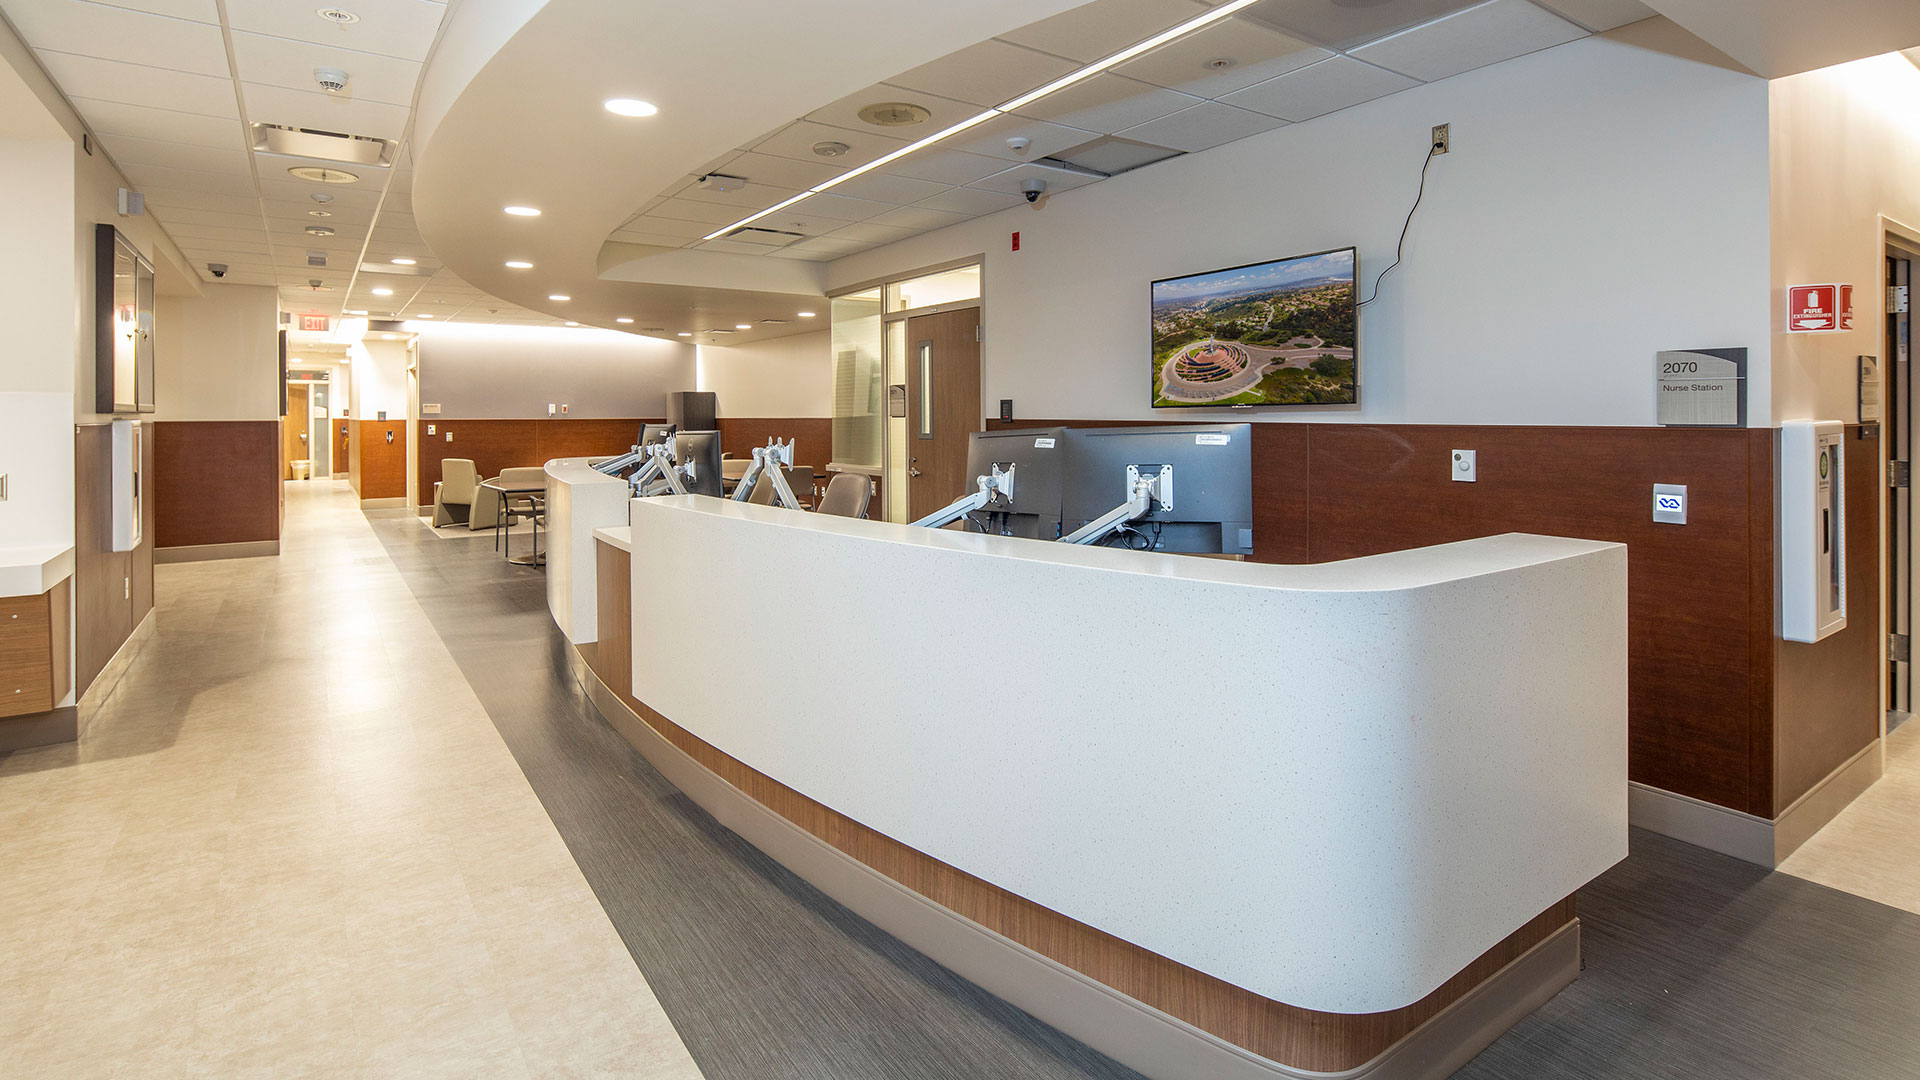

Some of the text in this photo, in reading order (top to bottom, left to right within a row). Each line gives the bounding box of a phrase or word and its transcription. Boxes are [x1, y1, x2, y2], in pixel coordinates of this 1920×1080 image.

[304, 317, 325, 330] EXIT
[1663, 362, 1698, 374] 2070
[1663, 383, 1724, 392] Nurse Station
